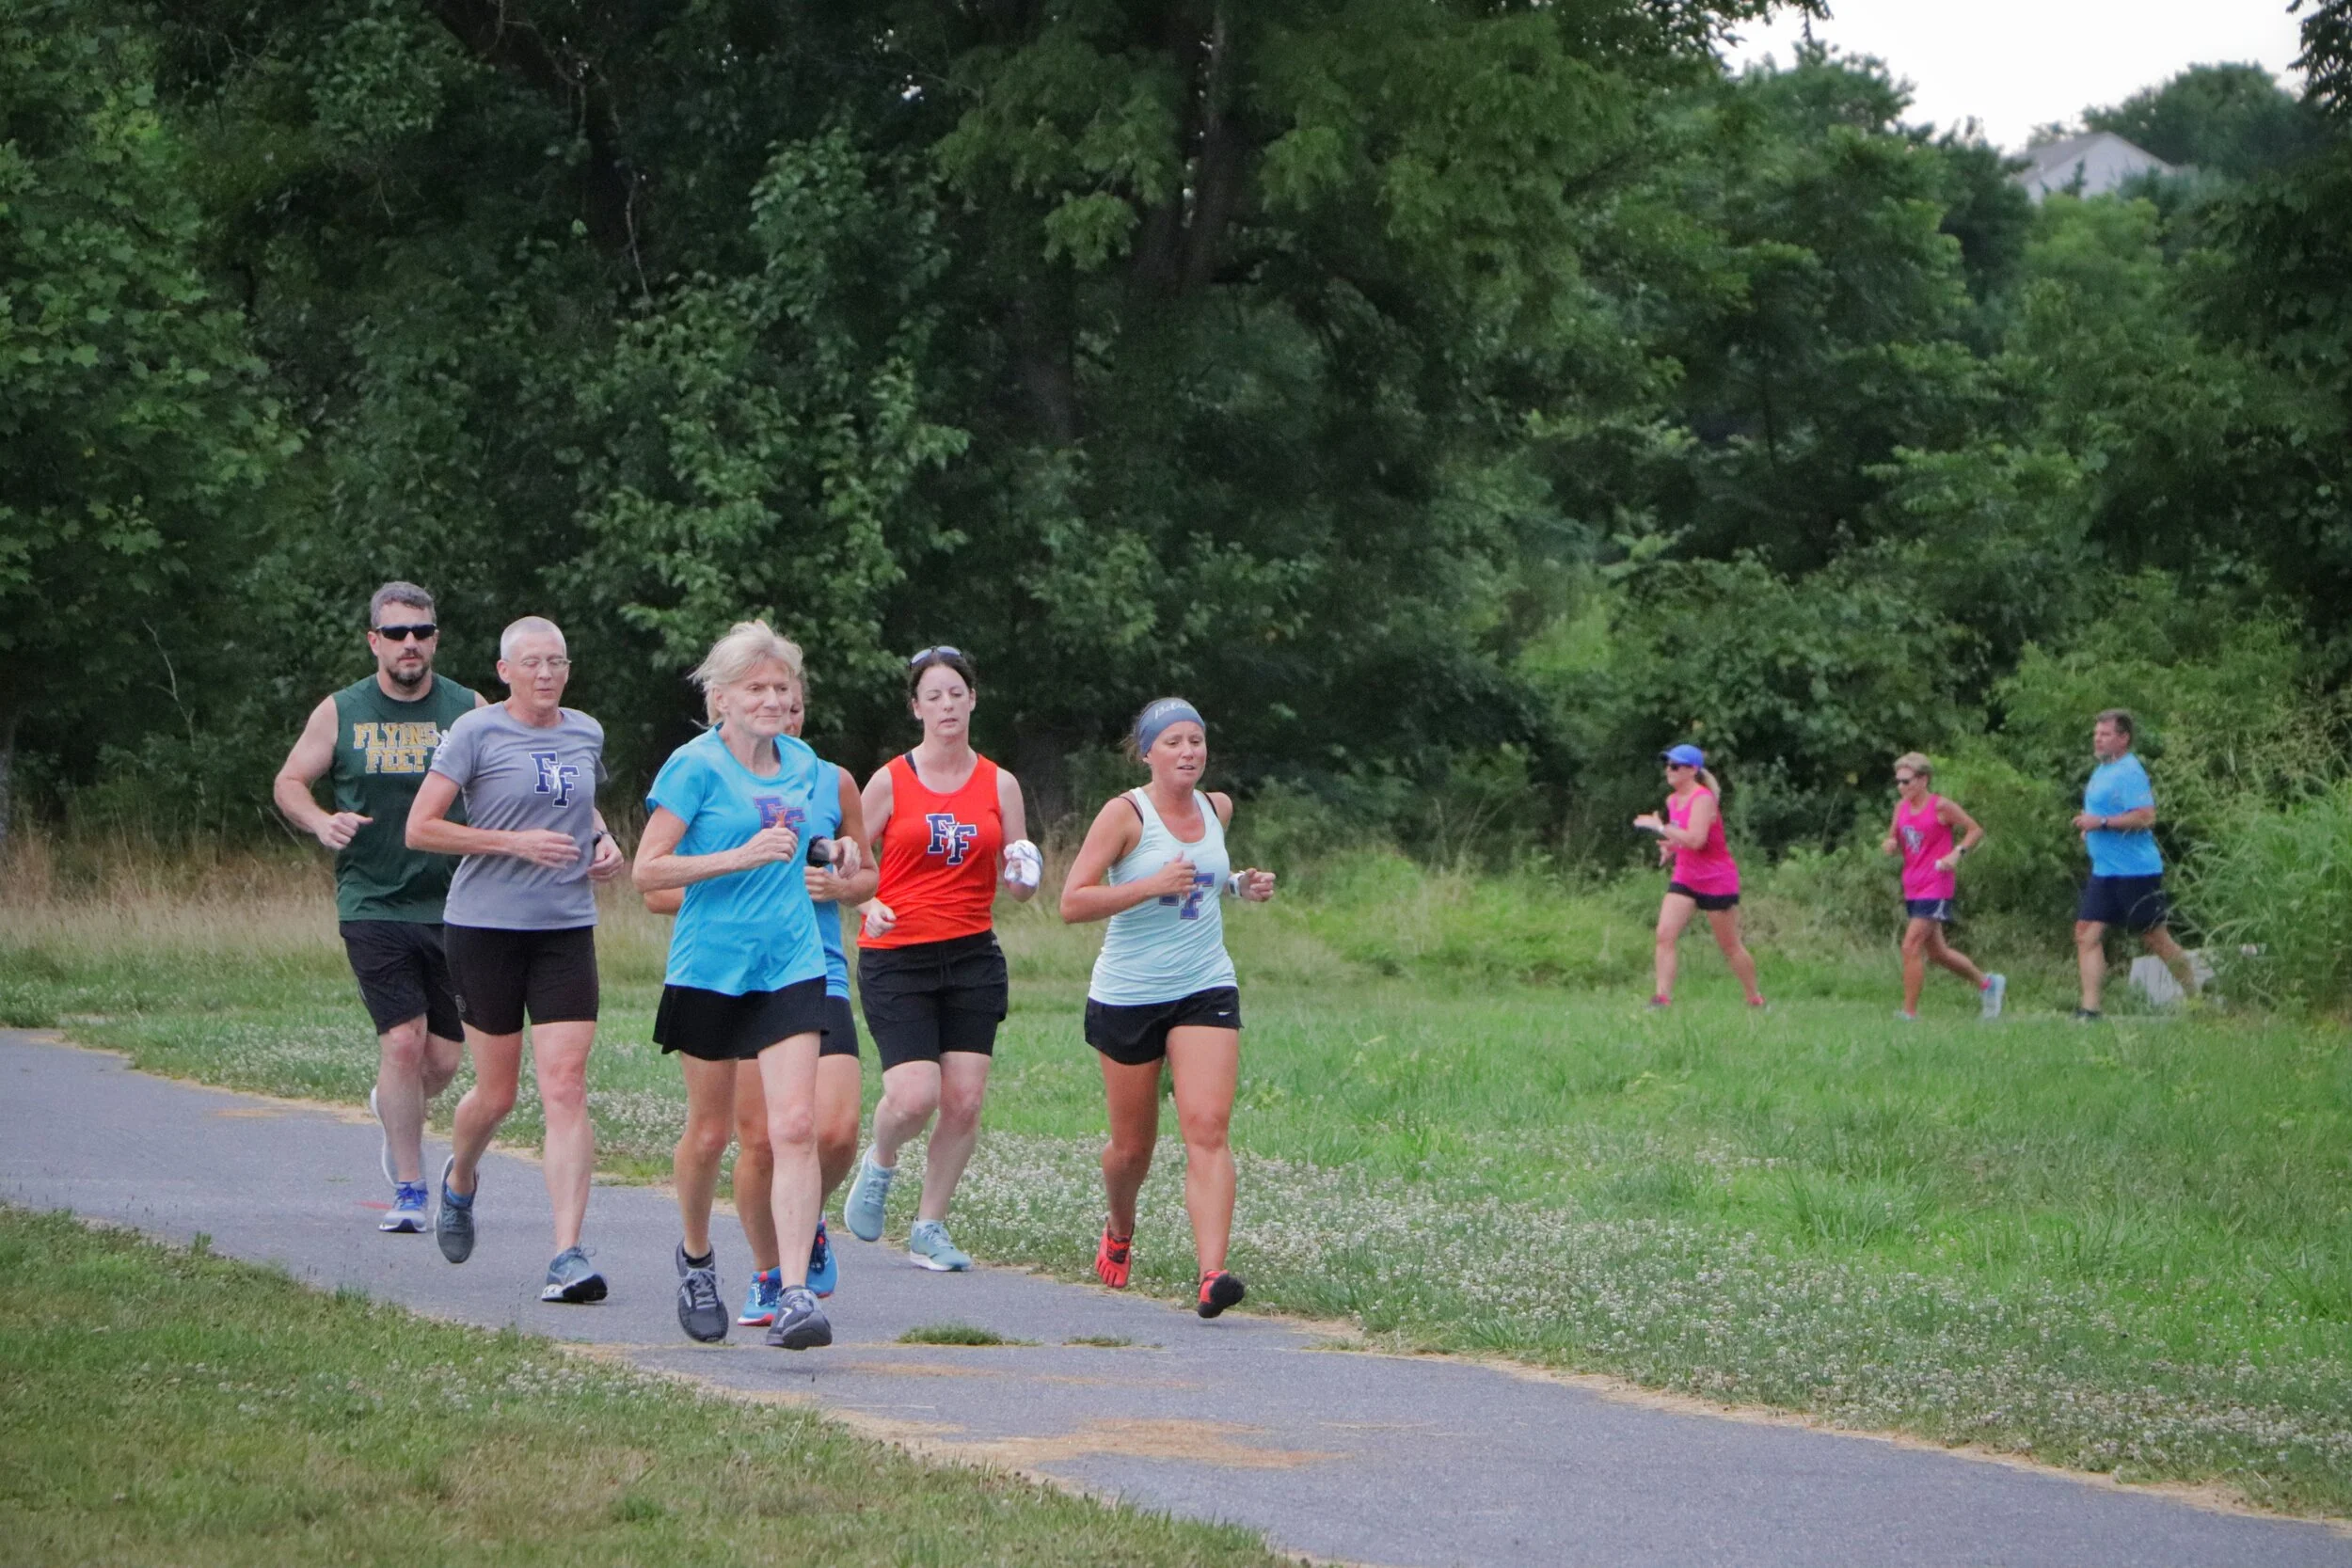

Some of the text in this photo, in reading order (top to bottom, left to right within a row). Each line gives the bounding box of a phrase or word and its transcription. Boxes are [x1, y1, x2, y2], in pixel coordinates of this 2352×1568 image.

[354, 722, 438, 749] FLYING
[365, 747, 428, 773] FEET
[529, 752, 580, 808] FF
[926, 814, 977, 864] FF
